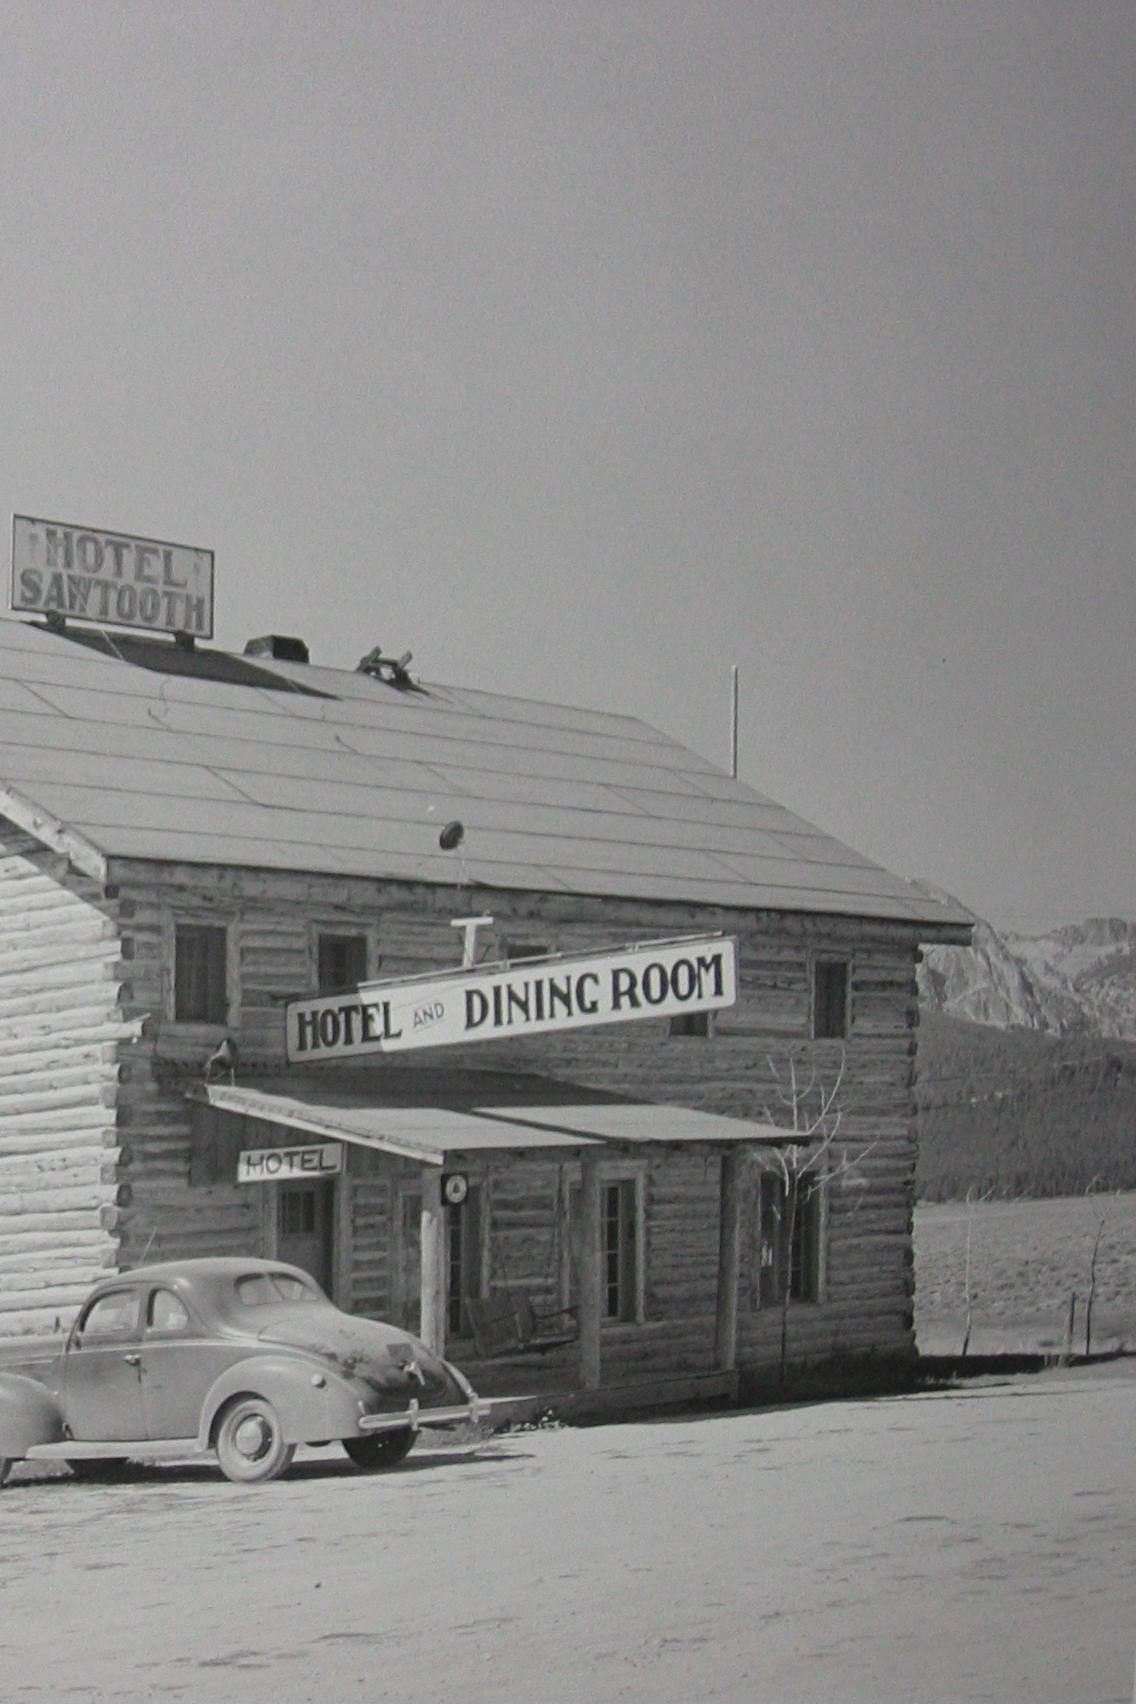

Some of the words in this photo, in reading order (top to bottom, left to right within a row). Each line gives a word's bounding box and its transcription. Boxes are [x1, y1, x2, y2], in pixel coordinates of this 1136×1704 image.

[45, 527, 187, 589] HOTEL
[20, 567, 206, 632] SAWTOOTH
[297, 1001, 403, 1051] HOTEL
[414, 1001, 445, 1029] AND
[465, 972, 600, 1031] DINING
[611, 953, 724, 1011] ROOM
[246, 1147, 338, 1177] HOTEL
